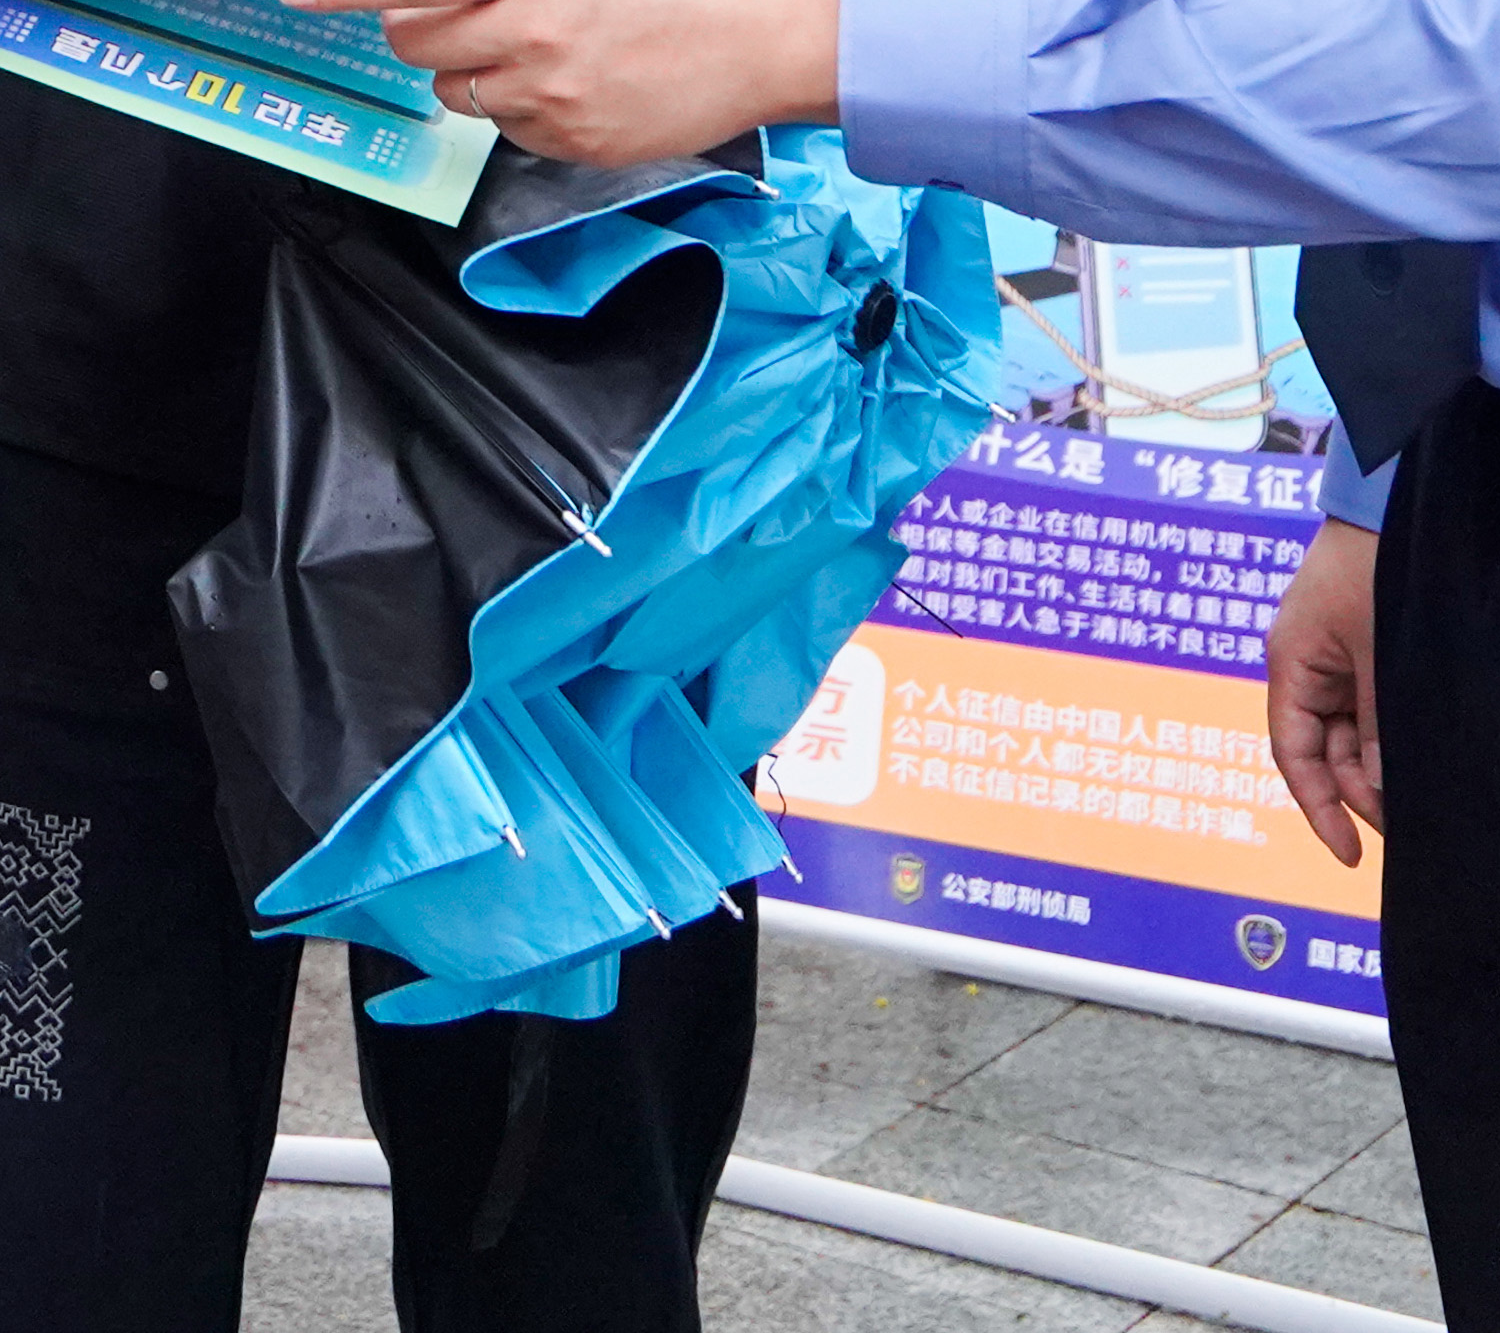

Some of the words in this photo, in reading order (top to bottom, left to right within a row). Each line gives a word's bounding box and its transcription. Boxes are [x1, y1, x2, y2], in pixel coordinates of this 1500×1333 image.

[888, 714, 1298, 811] 公司和个人都无权删除和修
[941, 871, 1092, 927] 公安部刑侦局
